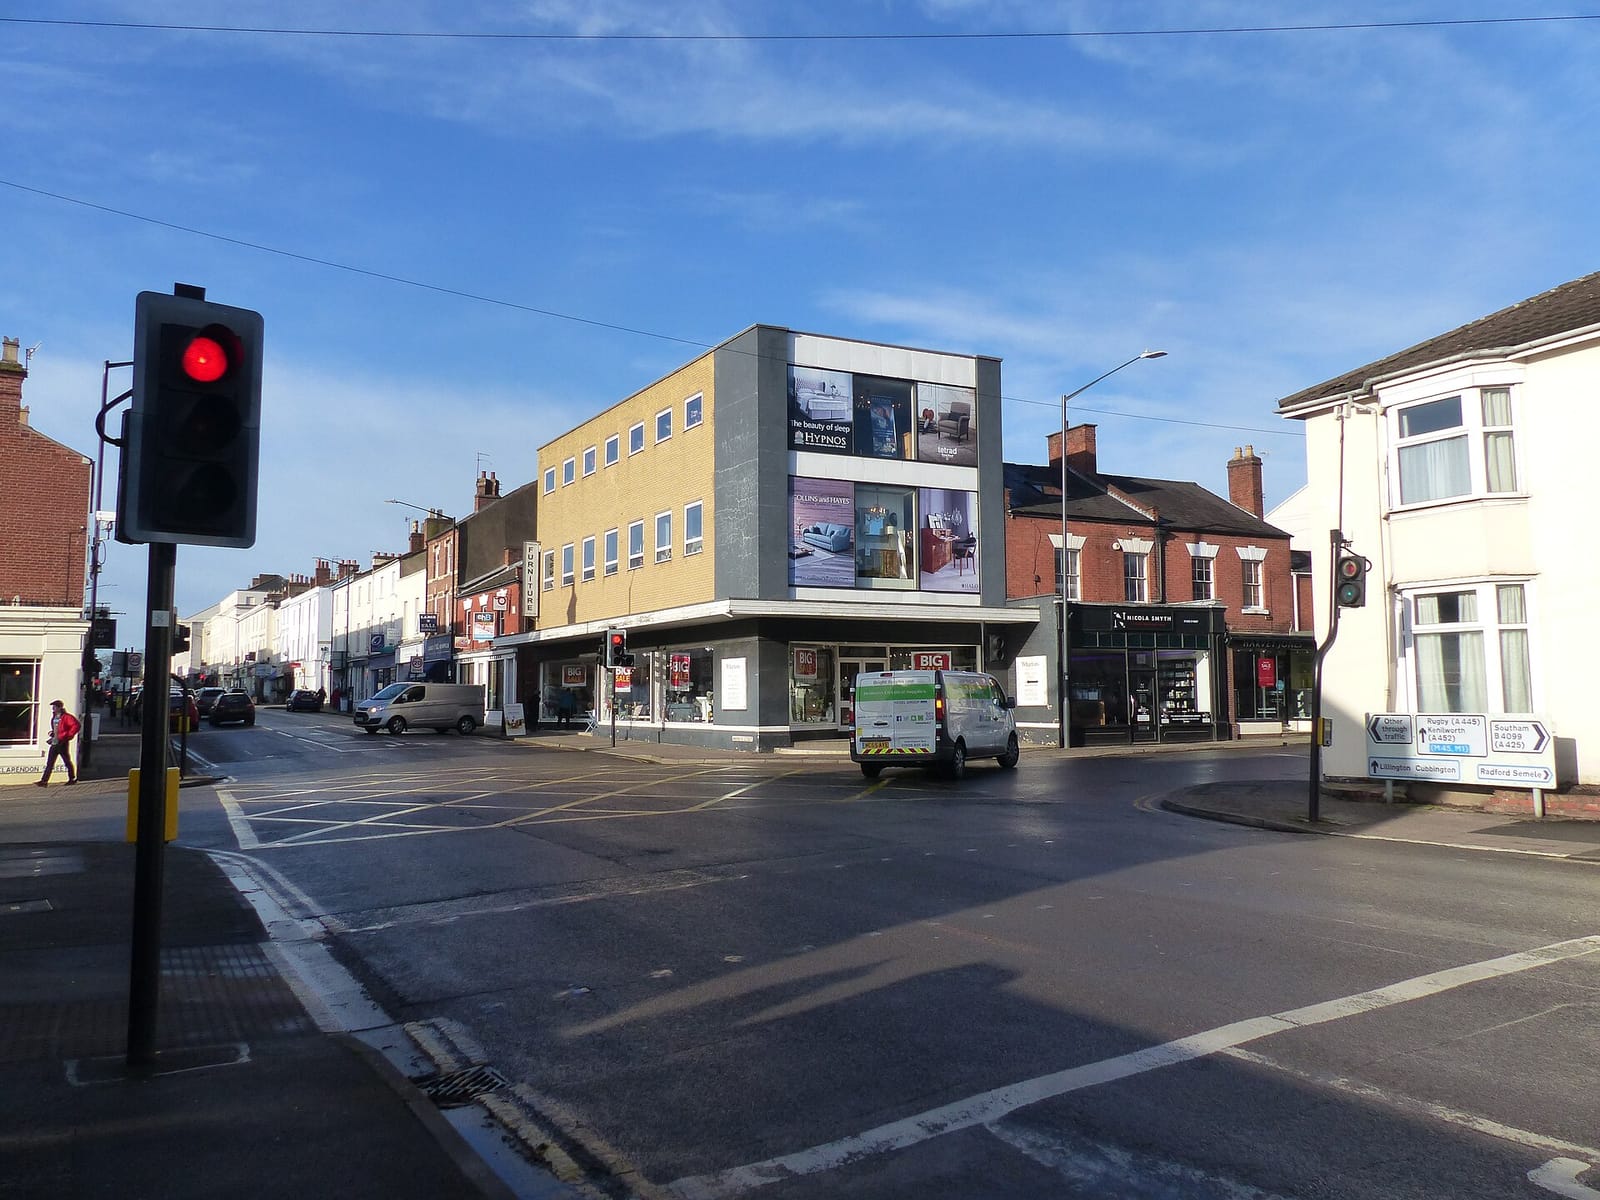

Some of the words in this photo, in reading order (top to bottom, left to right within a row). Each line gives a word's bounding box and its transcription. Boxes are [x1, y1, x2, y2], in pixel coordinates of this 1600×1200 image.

[803, 421, 825, 431] beauty
[834, 425, 851, 433] sleep
[805, 432, 847, 445] HYPNOS
[937, 446, 957, 454] tetrad
[800, 653, 813, 663] BIG
[920, 655, 943, 667] BIG
[567, 667, 581, 675] BIG
[615, 667, 631, 675] BIG
[672, 661, 688, 672] BIG
[1427, 718, 1449, 726] Rugby
[1380, 764, 1411, 773] Lillington
[1416, 765, 1456, 774] Cubbington
[1480, 768, 1511, 777] Radford
[1512, 771, 1542, 779] Semele
